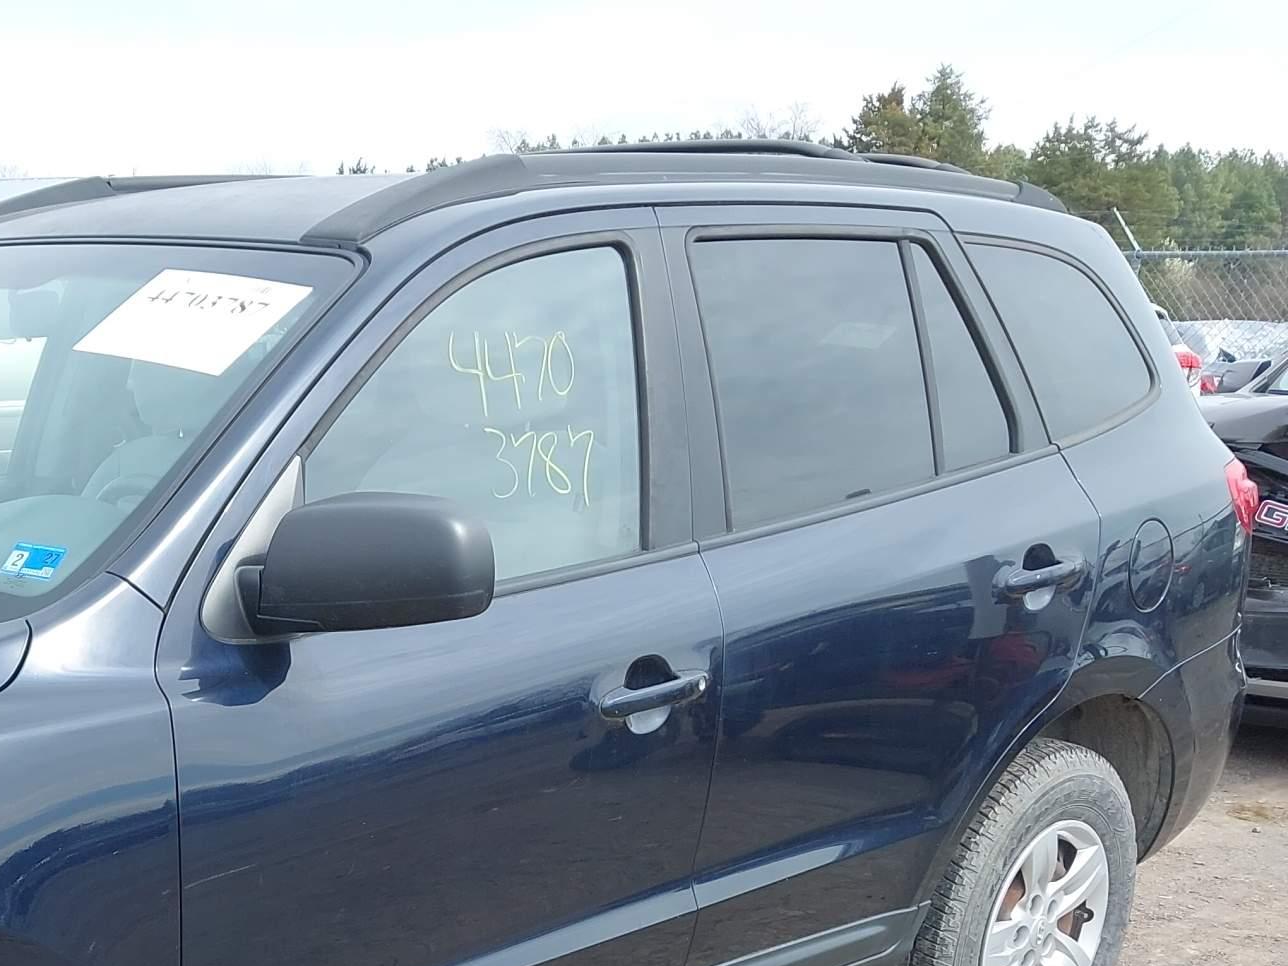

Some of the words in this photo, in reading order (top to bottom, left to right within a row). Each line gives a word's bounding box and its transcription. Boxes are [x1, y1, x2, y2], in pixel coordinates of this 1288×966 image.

[448, 329, 575, 417] 4470
[483, 424, 594, 507] 3787
[11, 553, 25, 567] 2
[42, 552, 61, 565] 27
